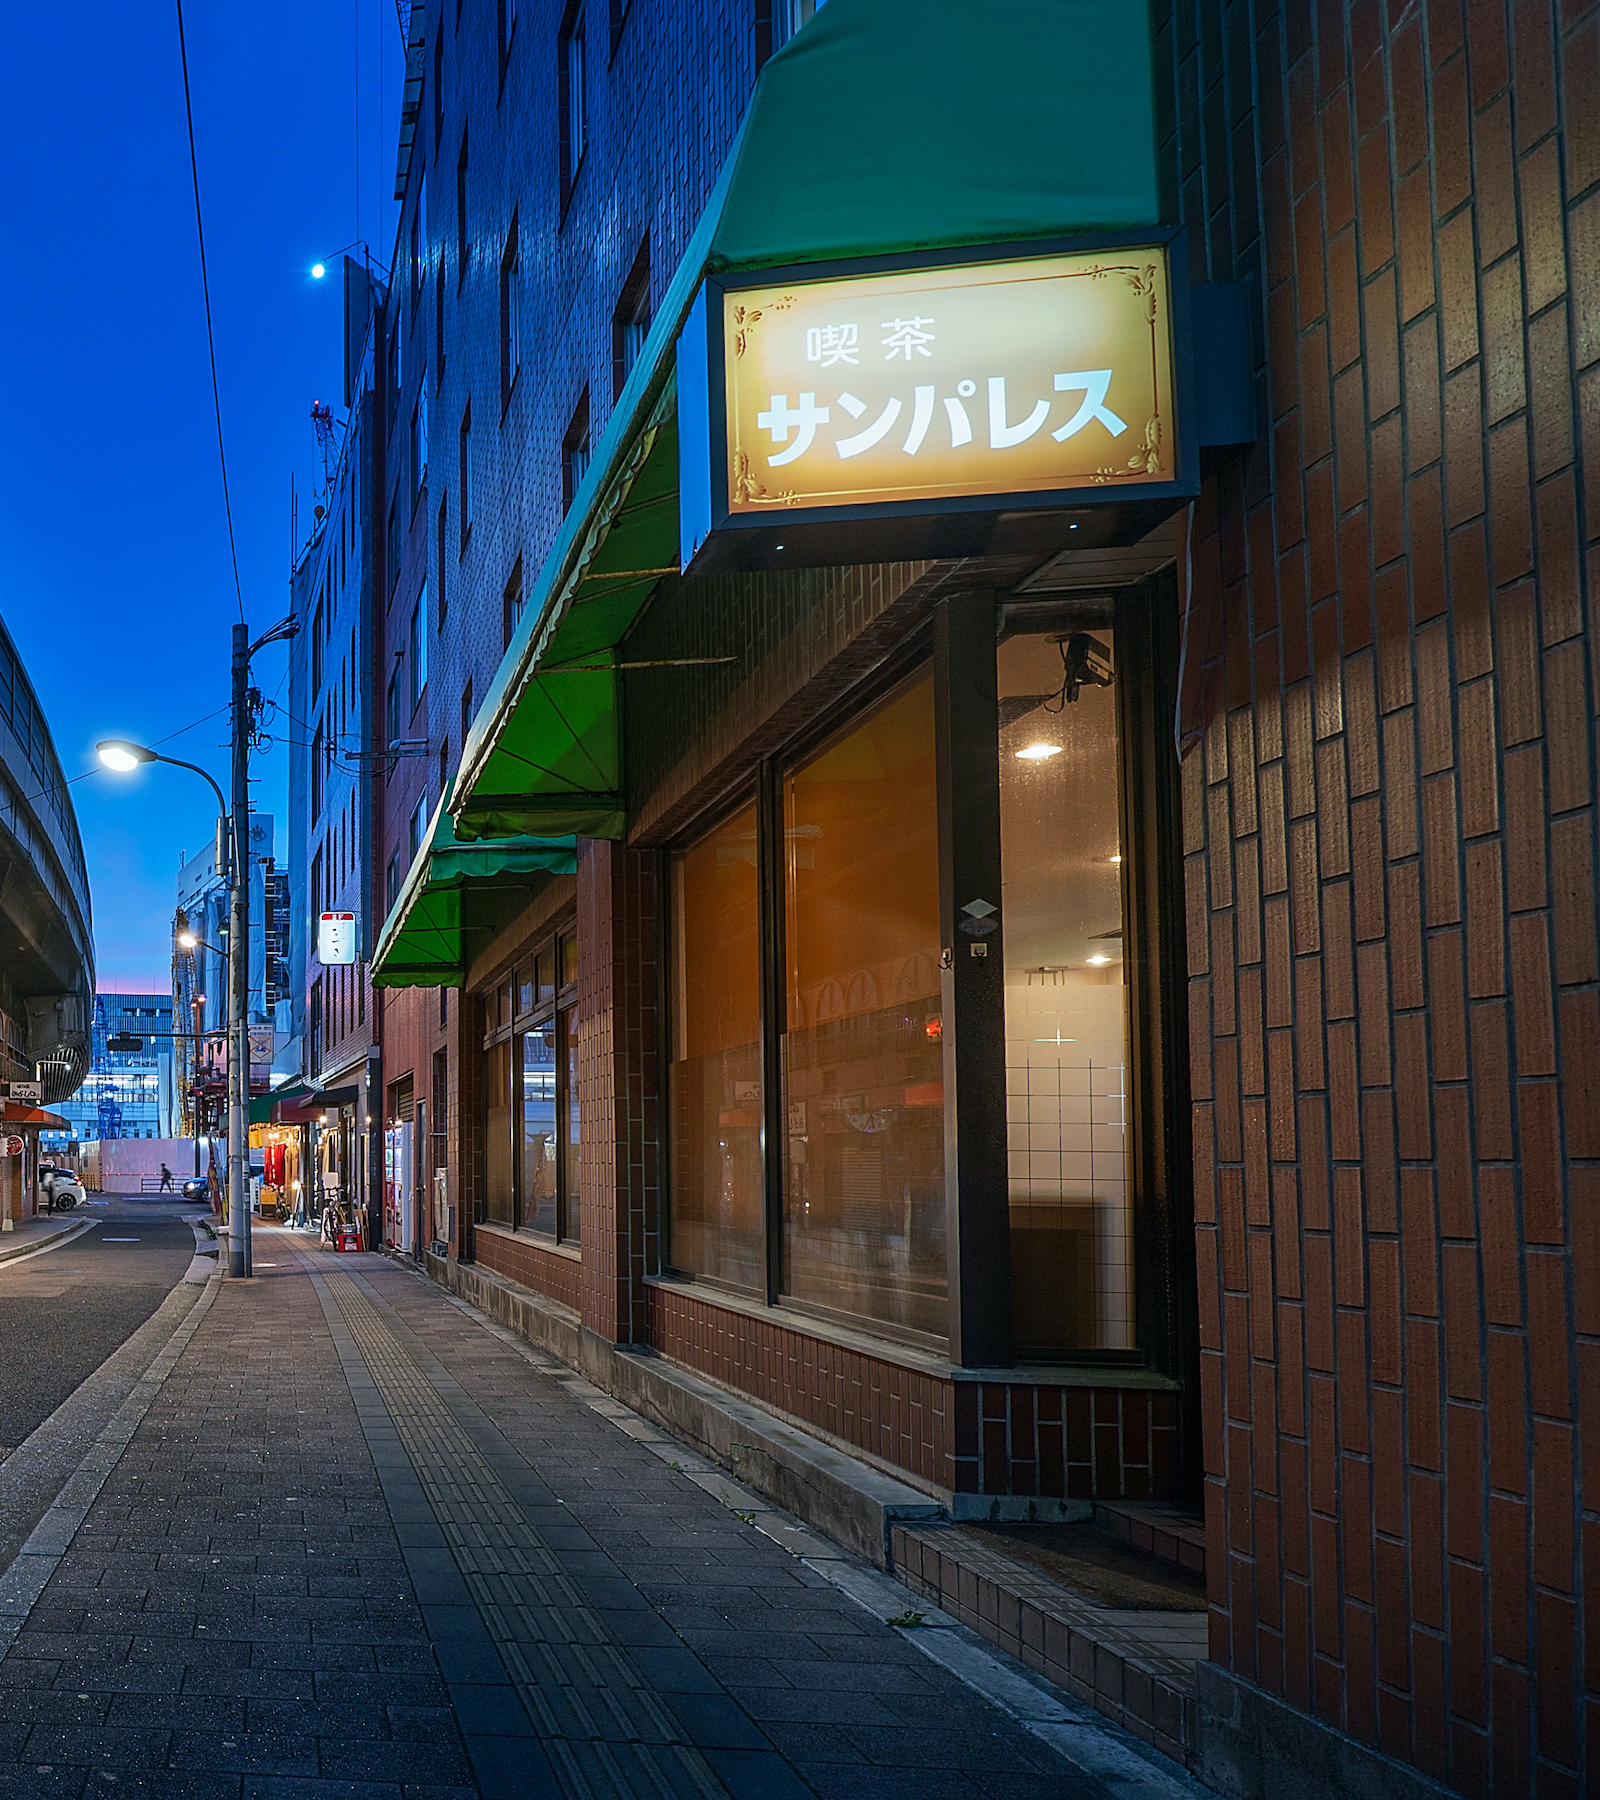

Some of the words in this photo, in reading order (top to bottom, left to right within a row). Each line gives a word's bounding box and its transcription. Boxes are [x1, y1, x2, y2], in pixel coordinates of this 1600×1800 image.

[806, 315, 936, 368] 喫茶
[757, 368, 1129, 468] サンパレス
